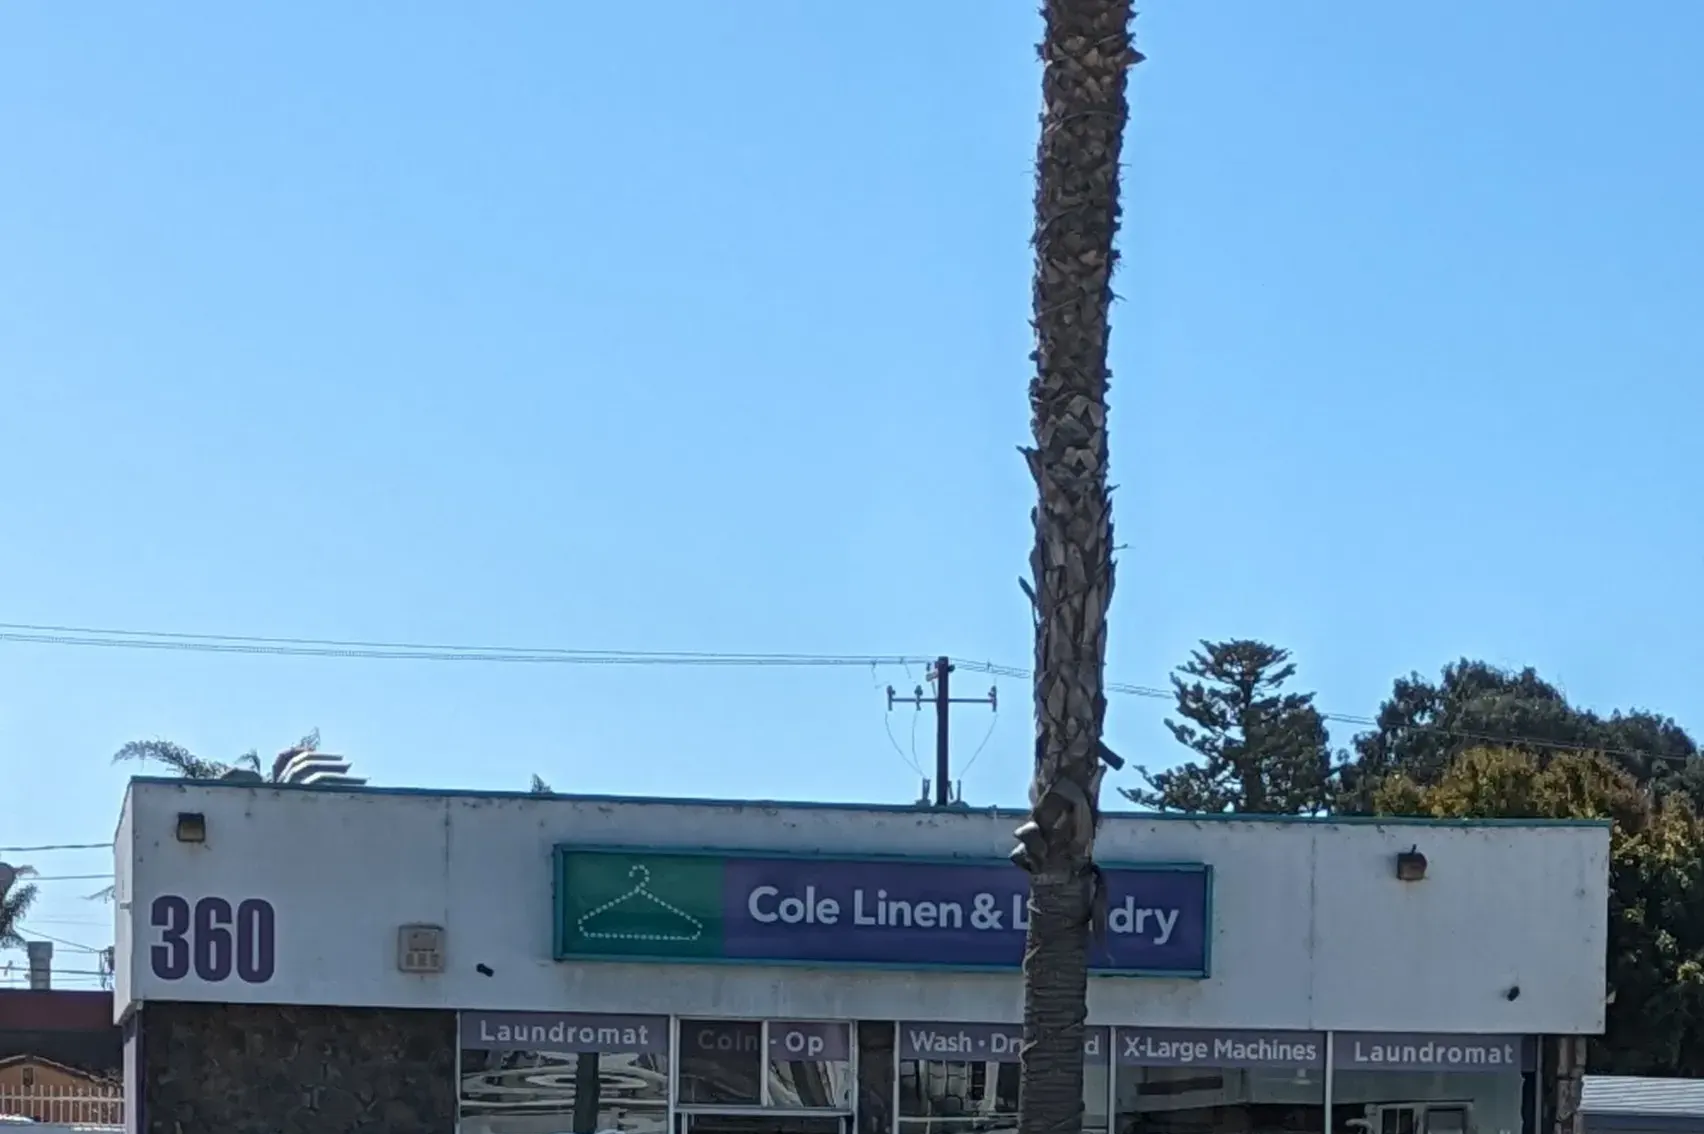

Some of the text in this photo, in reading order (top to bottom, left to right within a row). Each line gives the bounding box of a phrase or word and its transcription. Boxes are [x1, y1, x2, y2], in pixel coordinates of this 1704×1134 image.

[748, 885, 1180, 945] Cole Linen & Ldry
[150, 894, 276, 983] 360
[480, 1019, 649, 1046] Laundromat
[697, 1029, 758, 1052] Coin
[910, 1029, 972, 1053] Wash
[1124, 1035, 1208, 1062] X-Large
[1214, 1037, 1317, 1062] Machines
[1355, 1040, 1514, 1065] Laundromat
